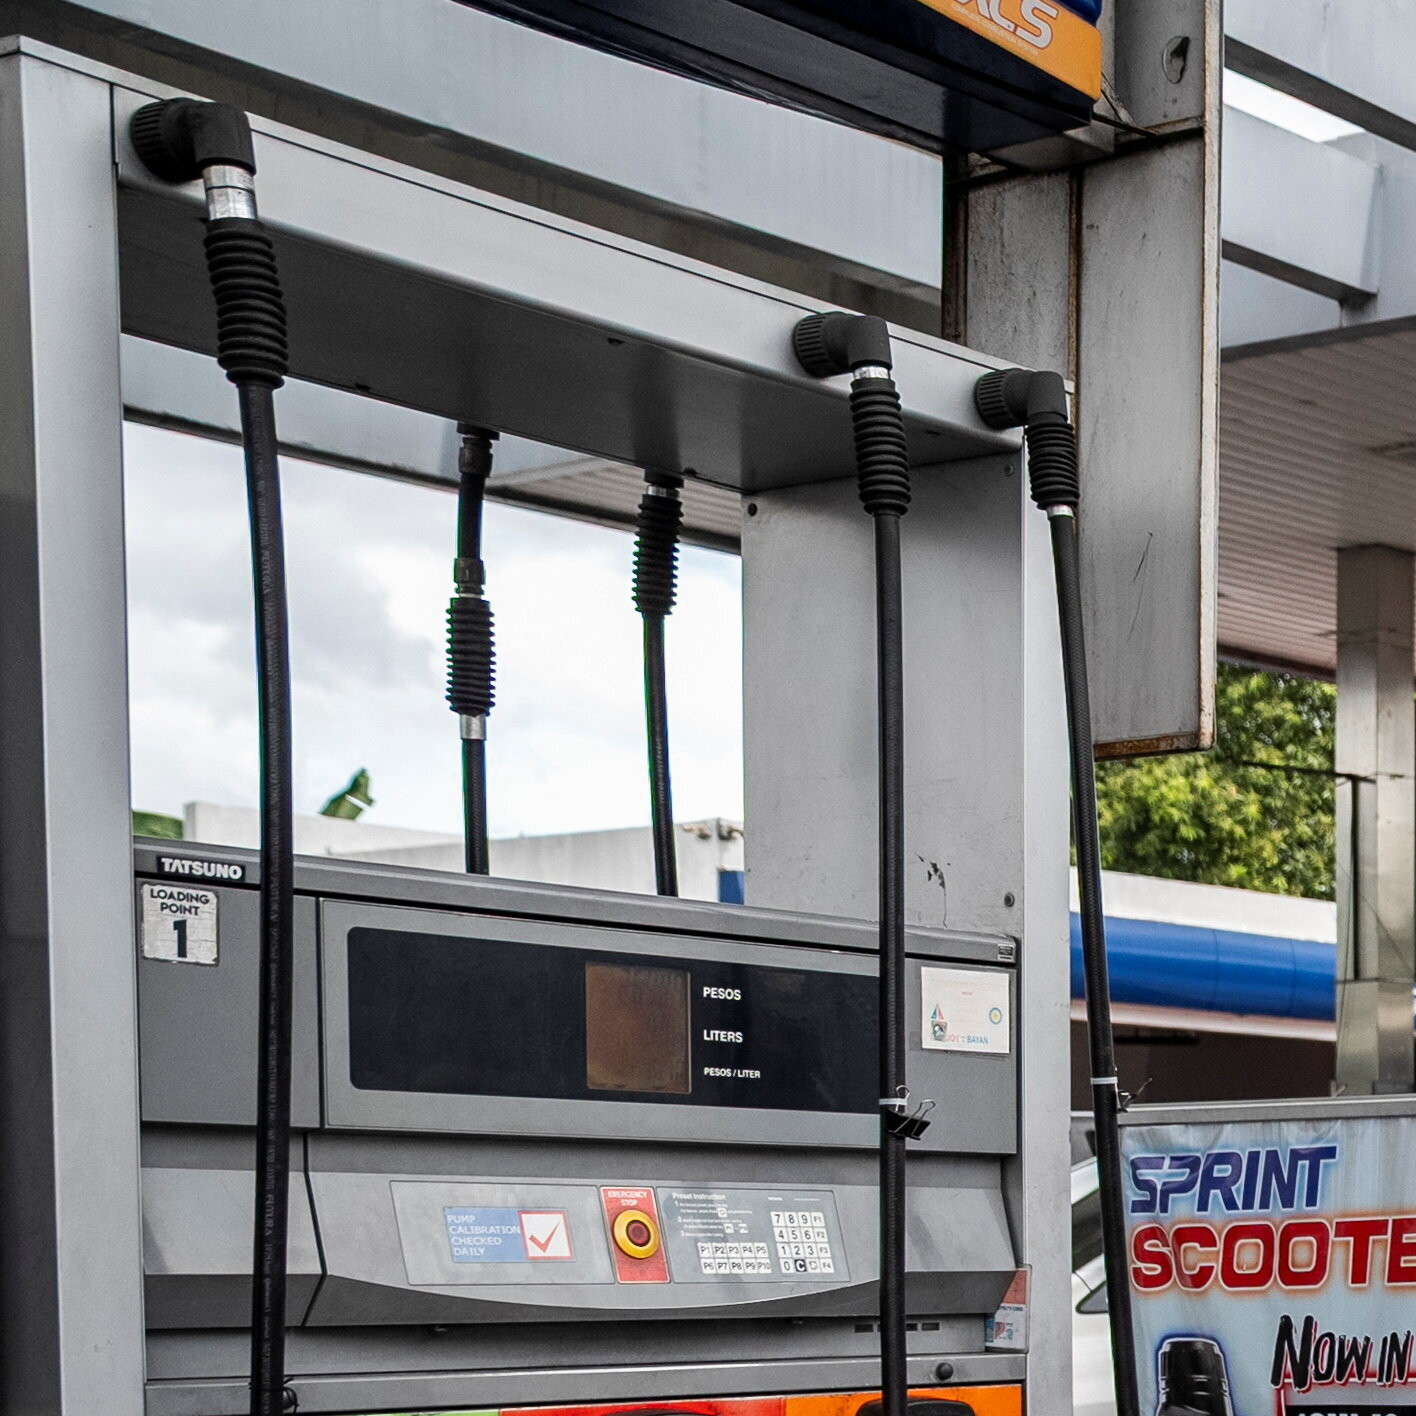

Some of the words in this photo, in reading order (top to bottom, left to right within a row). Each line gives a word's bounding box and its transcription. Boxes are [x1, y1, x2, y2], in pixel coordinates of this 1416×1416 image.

[161, 857, 243, 880] TATSUNO
[150, 888, 210, 905] LOADING
[160, 902, 200, 916] POINT
[172, 919, 188, 959] 1
[703, 986, 742, 1001] PESOS
[703, 1029, 743, 1043] LITERS
[704, 1067, 732, 1077] PESOS
[737, 1069, 761, 1079] LITER
[1130, 1145, 1337, 1214] SPRINT
[447, 1214, 476, 1224] PUMP
[774, 1214, 781, 1224] 7
[788, 1214, 795, 1224] 8
[801, 1214, 808, 1224] 9
[813, 1215, 822, 1223] F1
[449, 1225, 521, 1236] CALIBRATION
[777, 1230, 784, 1240] 4
[791, 1230, 798, 1240] 5
[804, 1230, 811, 1240] 6
[816, 1231, 825, 1239] F2
[451, 1237, 502, 1246] CHECKED
[454, 1247, 486, 1256] DAILY
[701, 1246, 710, 1254] P1
[714, 1246, 725, 1254] P2
[728, 1246, 739, 1254] P3
[742, 1246, 753, 1254] P4
[781, 1246, 786, 1255] 1
[794, 1245, 801, 1255] 2
[808, 1246, 814, 1255] 3
[718, 1262, 728, 1270] P7
[783, 1262, 790, 1271] 0
[798, 1262, 806, 1271] C
